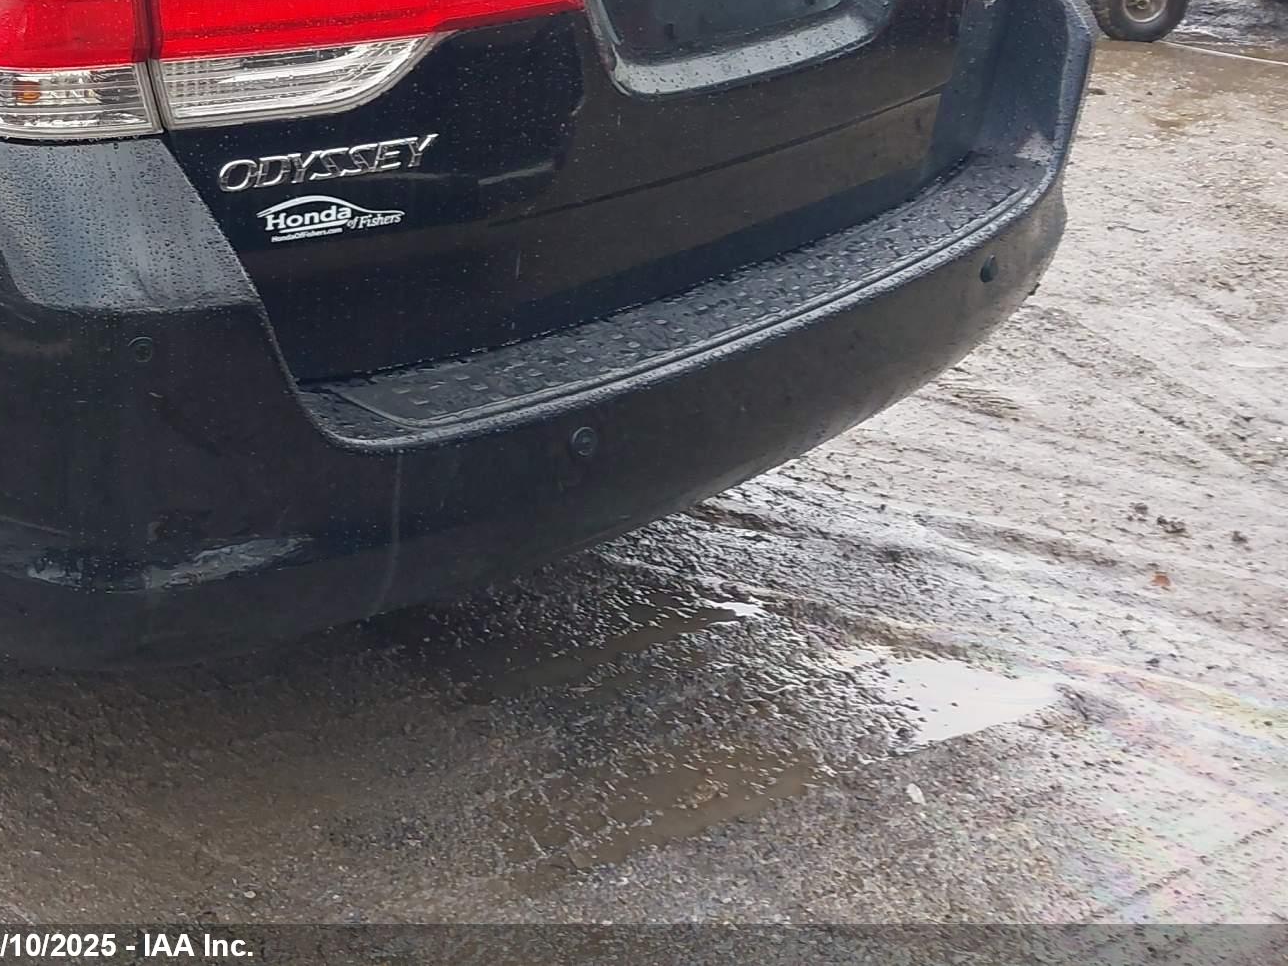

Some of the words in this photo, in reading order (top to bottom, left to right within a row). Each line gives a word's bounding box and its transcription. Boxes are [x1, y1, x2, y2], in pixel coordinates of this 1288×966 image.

[218, 132, 439, 193] ODYSSEY
[265, 205, 352, 231] Honda
[346, 216, 360, 230] of
[357, 213, 402, 230] Fishers
